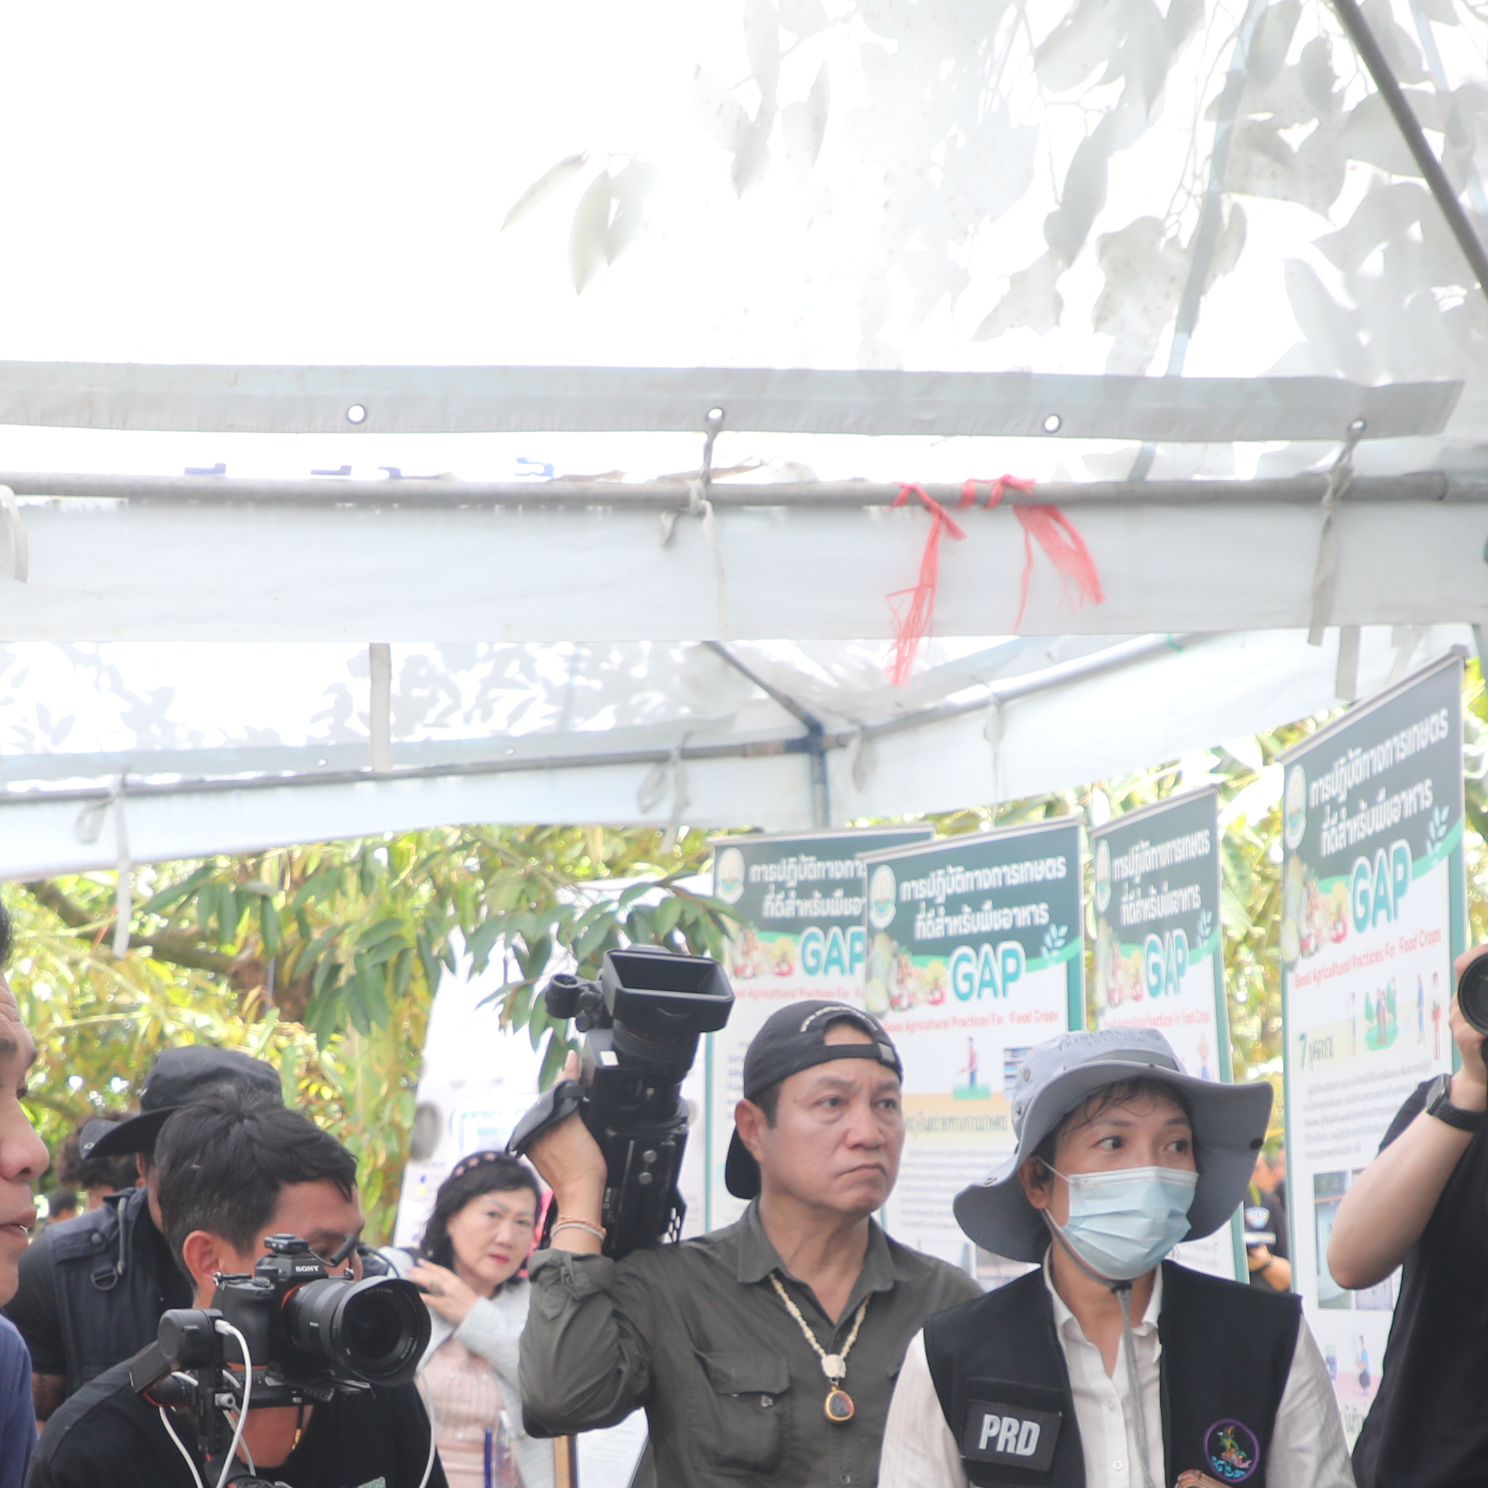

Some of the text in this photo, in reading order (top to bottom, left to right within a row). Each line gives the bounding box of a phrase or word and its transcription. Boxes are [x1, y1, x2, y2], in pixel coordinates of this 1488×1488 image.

[1309, 708, 1449, 807] การปฏิบัติทางการเกษตร
[1319, 778, 1433, 858] ที่ดีสำหรับพืชอาหาร
[900, 855, 1067, 904] การปฏิบัติทางการเกษตร
[1350, 838, 1413, 933] GAP
[914, 899, 1049, 941] ที่ดีสำหรับพืชอาหาร
[950, 941, 1026, 1002] GAP
[1144, 928, 1189, 998] GAP
[906, 1015, 950, 1034] Agricultural
[952, 1014, 989, 1027] Practices
[1010, 1011, 1032, 1023] Food
[1034, 1009, 1059, 1023] Crops
[295, 1265, 319, 1273] SONY
[978, 1413, 1041, 1456] PRD
